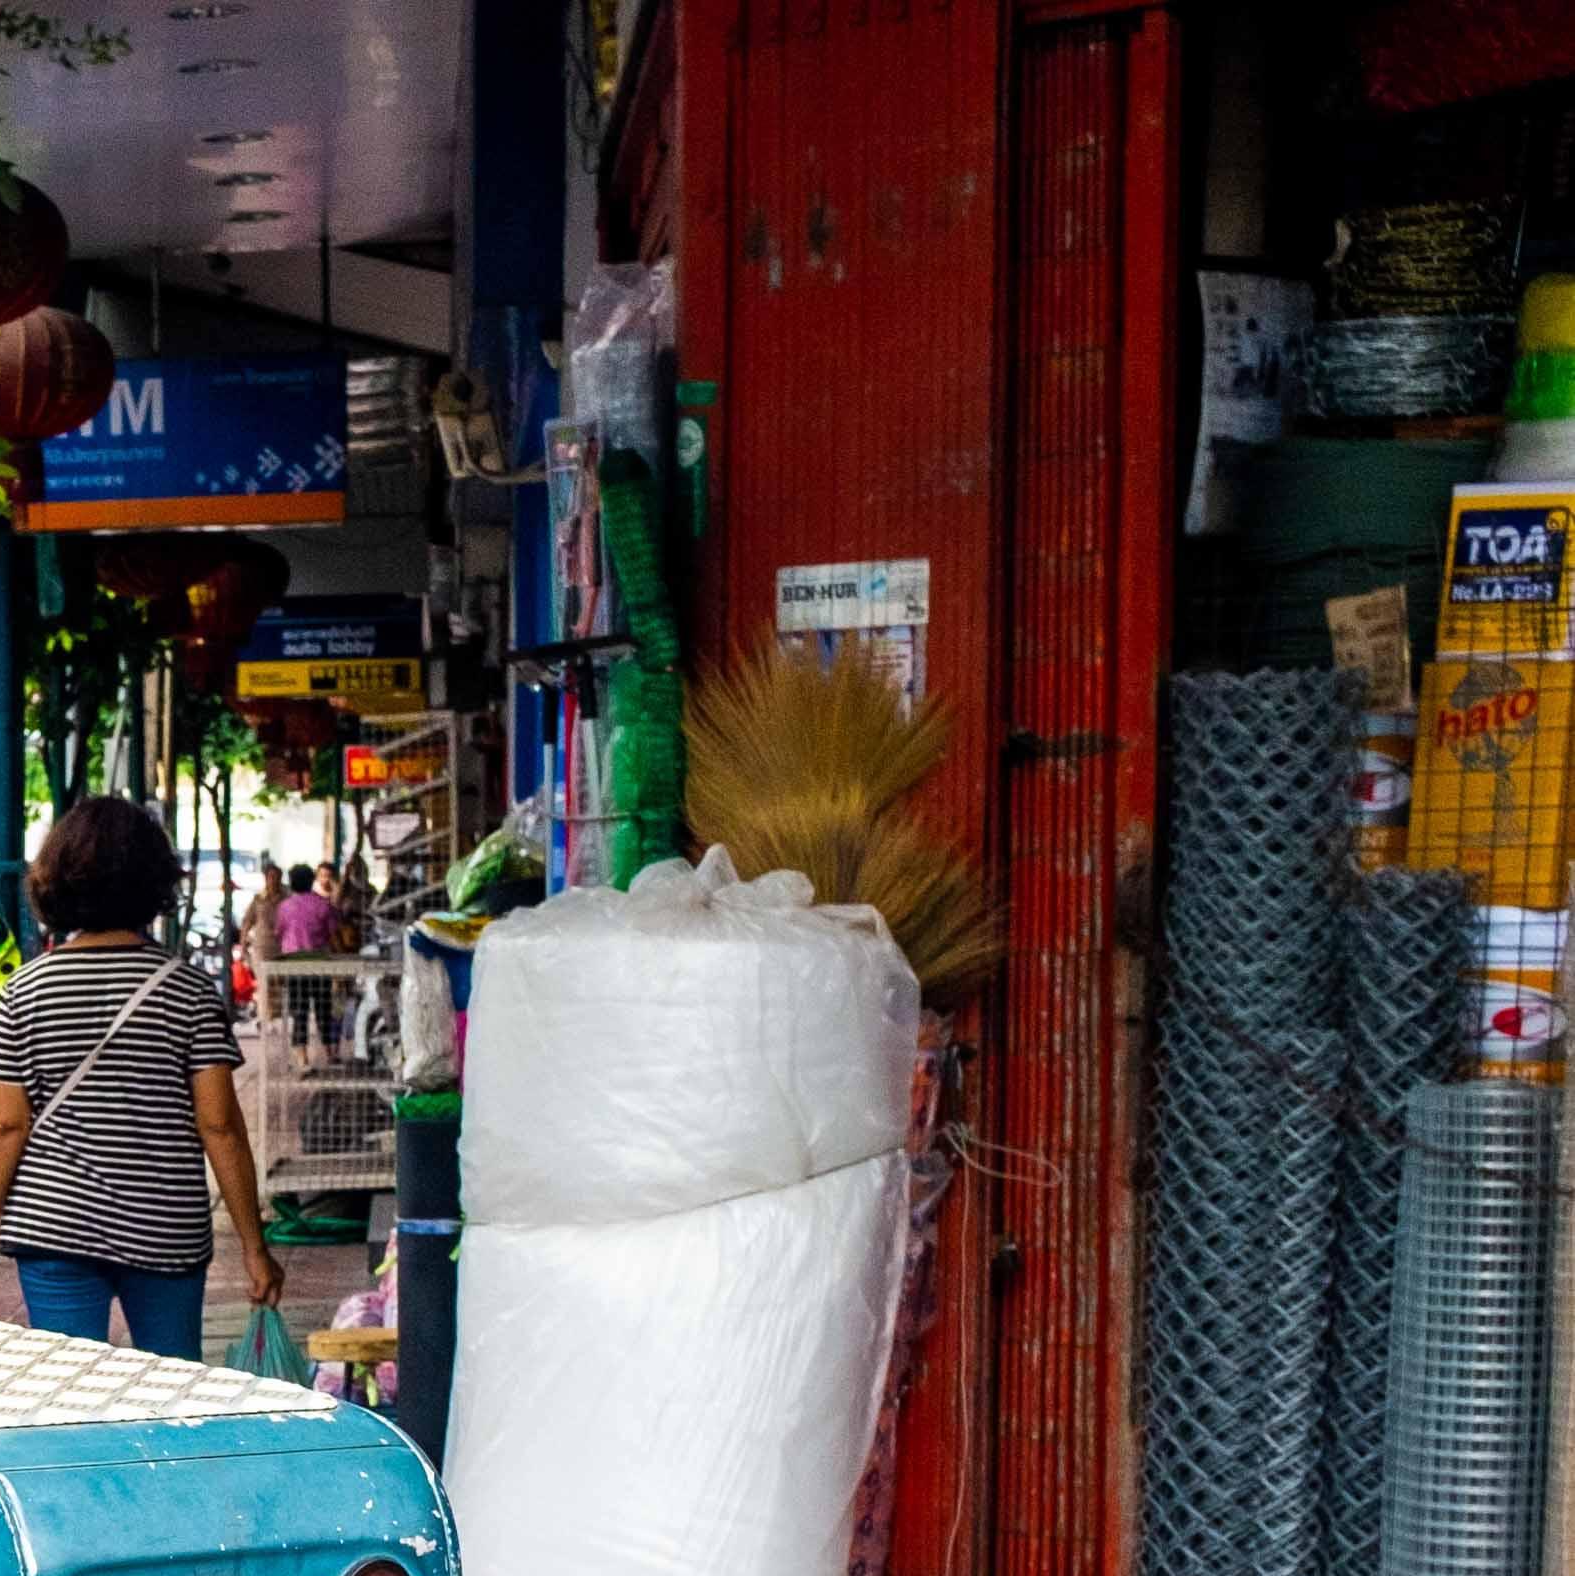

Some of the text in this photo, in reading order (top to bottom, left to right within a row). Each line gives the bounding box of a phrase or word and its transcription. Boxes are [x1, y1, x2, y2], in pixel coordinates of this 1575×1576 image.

[1465, 525, 1548, 564] TOA
[782, 582, 858, 603] BEN-HUR
[282, 640, 376, 657] auto lobby
